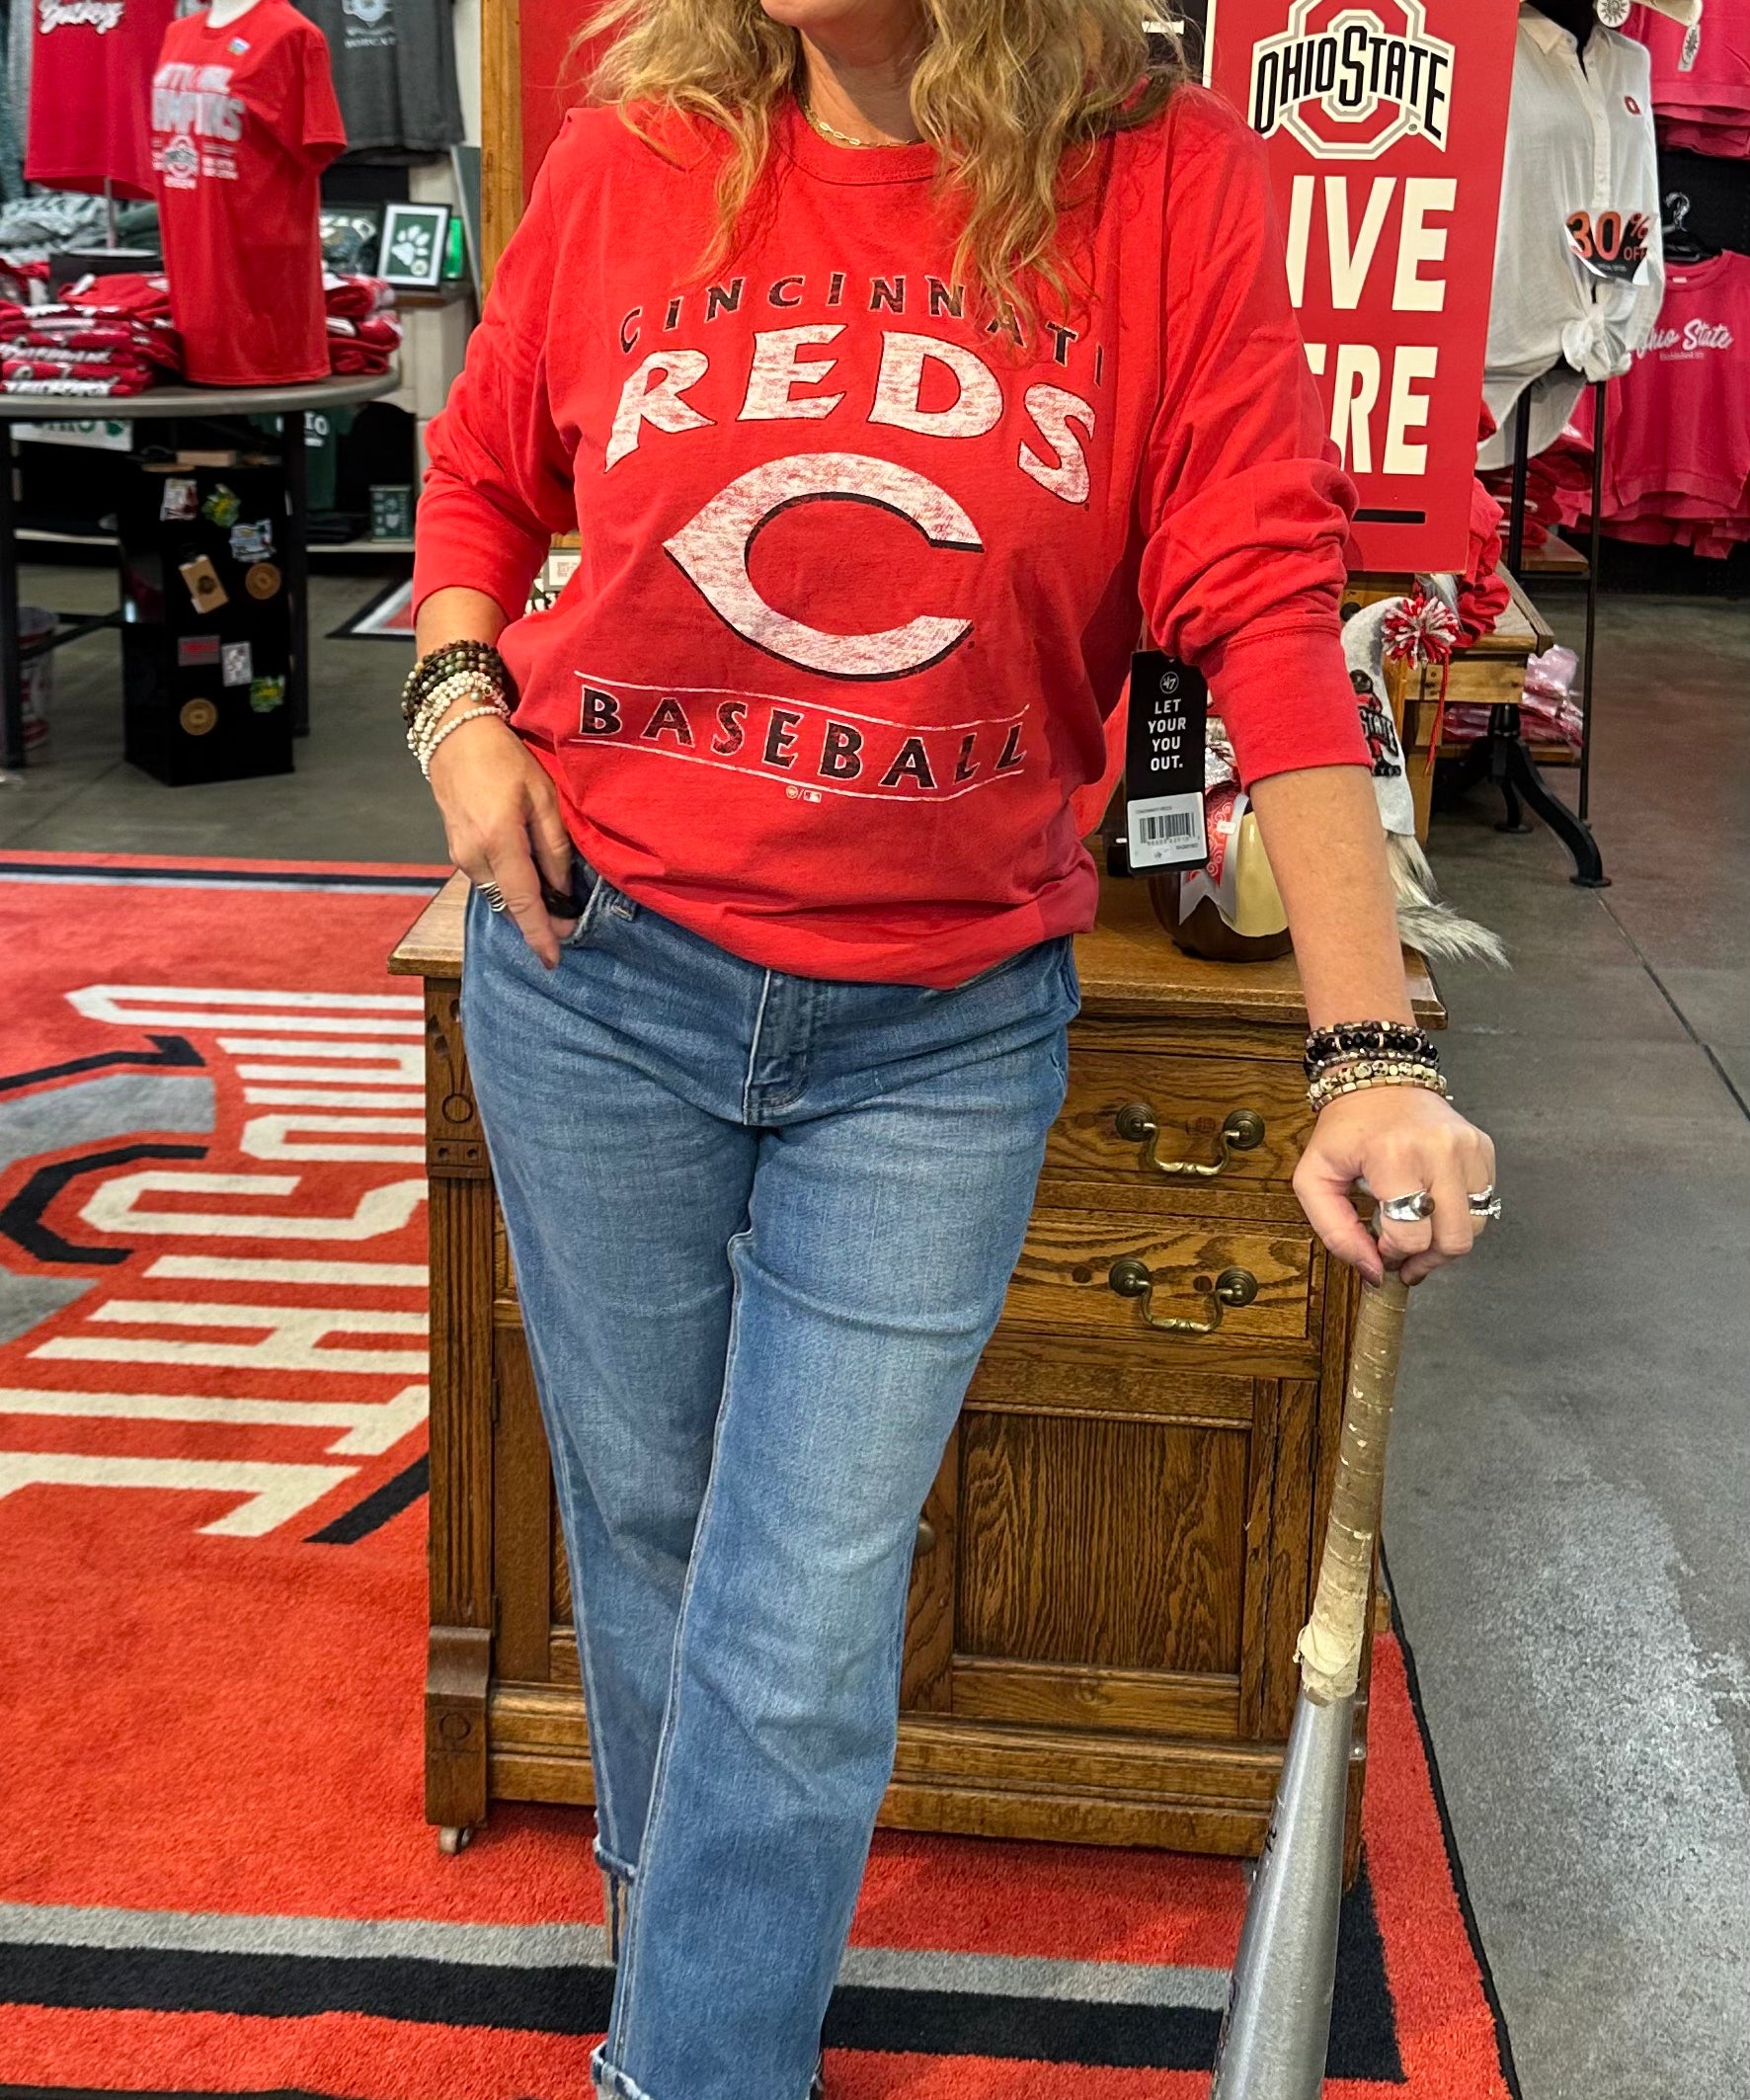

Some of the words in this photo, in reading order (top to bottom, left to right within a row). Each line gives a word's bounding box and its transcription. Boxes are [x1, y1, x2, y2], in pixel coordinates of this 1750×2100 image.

[1254, 37, 1337, 134] OHIO
[1338, 26, 1449, 141] STATE
[1286, 176, 1458, 311] IVE
[619, 272, 1104, 387] CINCINNATI
[1636, 326, 1681, 360] hio
[1682, 318, 1733, 351] State
[603, 323, 1096, 506] REDS
[1304, 343, 1439, 475] RE
[579, 684, 1029, 789] BASEBALL
[1147, 716, 1187, 734] YOUR
[1152, 736, 1181, 753] YOU
[1153, 698, 1182, 715] LET
[1151, 755, 1184, 771] OUT.
